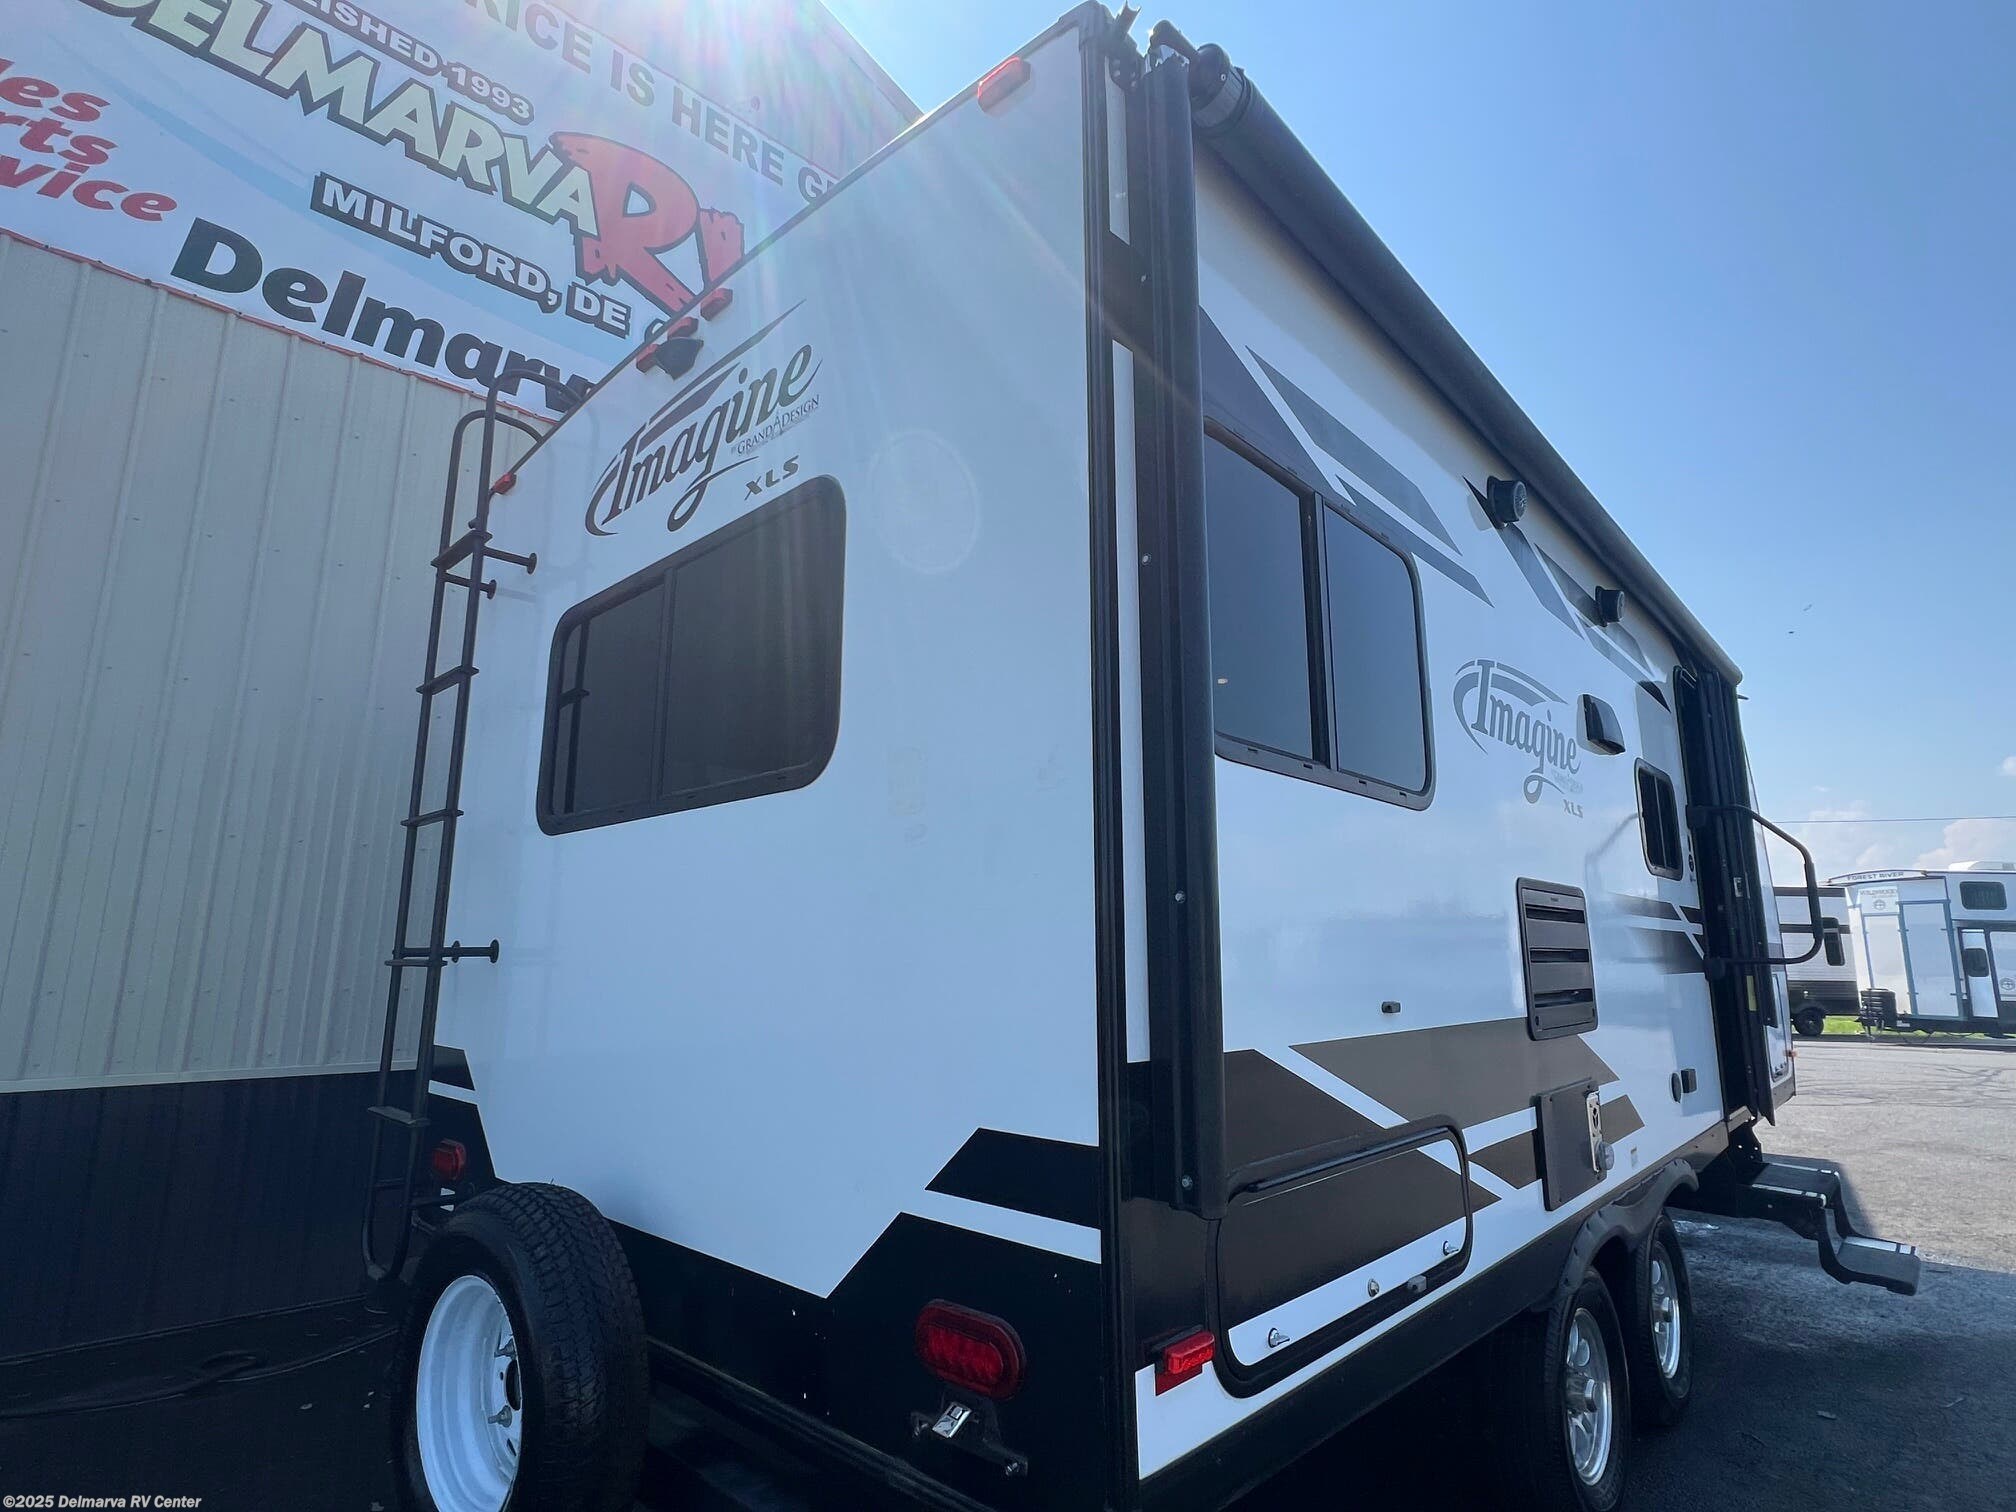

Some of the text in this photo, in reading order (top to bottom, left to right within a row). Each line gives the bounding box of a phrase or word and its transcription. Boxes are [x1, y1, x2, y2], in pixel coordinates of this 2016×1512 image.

[451, 66, 531, 119] 1993
[611, 49, 655, 107] IS
[672, 85, 785, 187] HERE
[171, 217, 597, 413] Delmarv
[573, 289, 630, 333] DE
[585, 344, 823, 536] Imagine
[744, 455, 799, 500] XLS
[1453, 659, 1582, 804] Imagine
